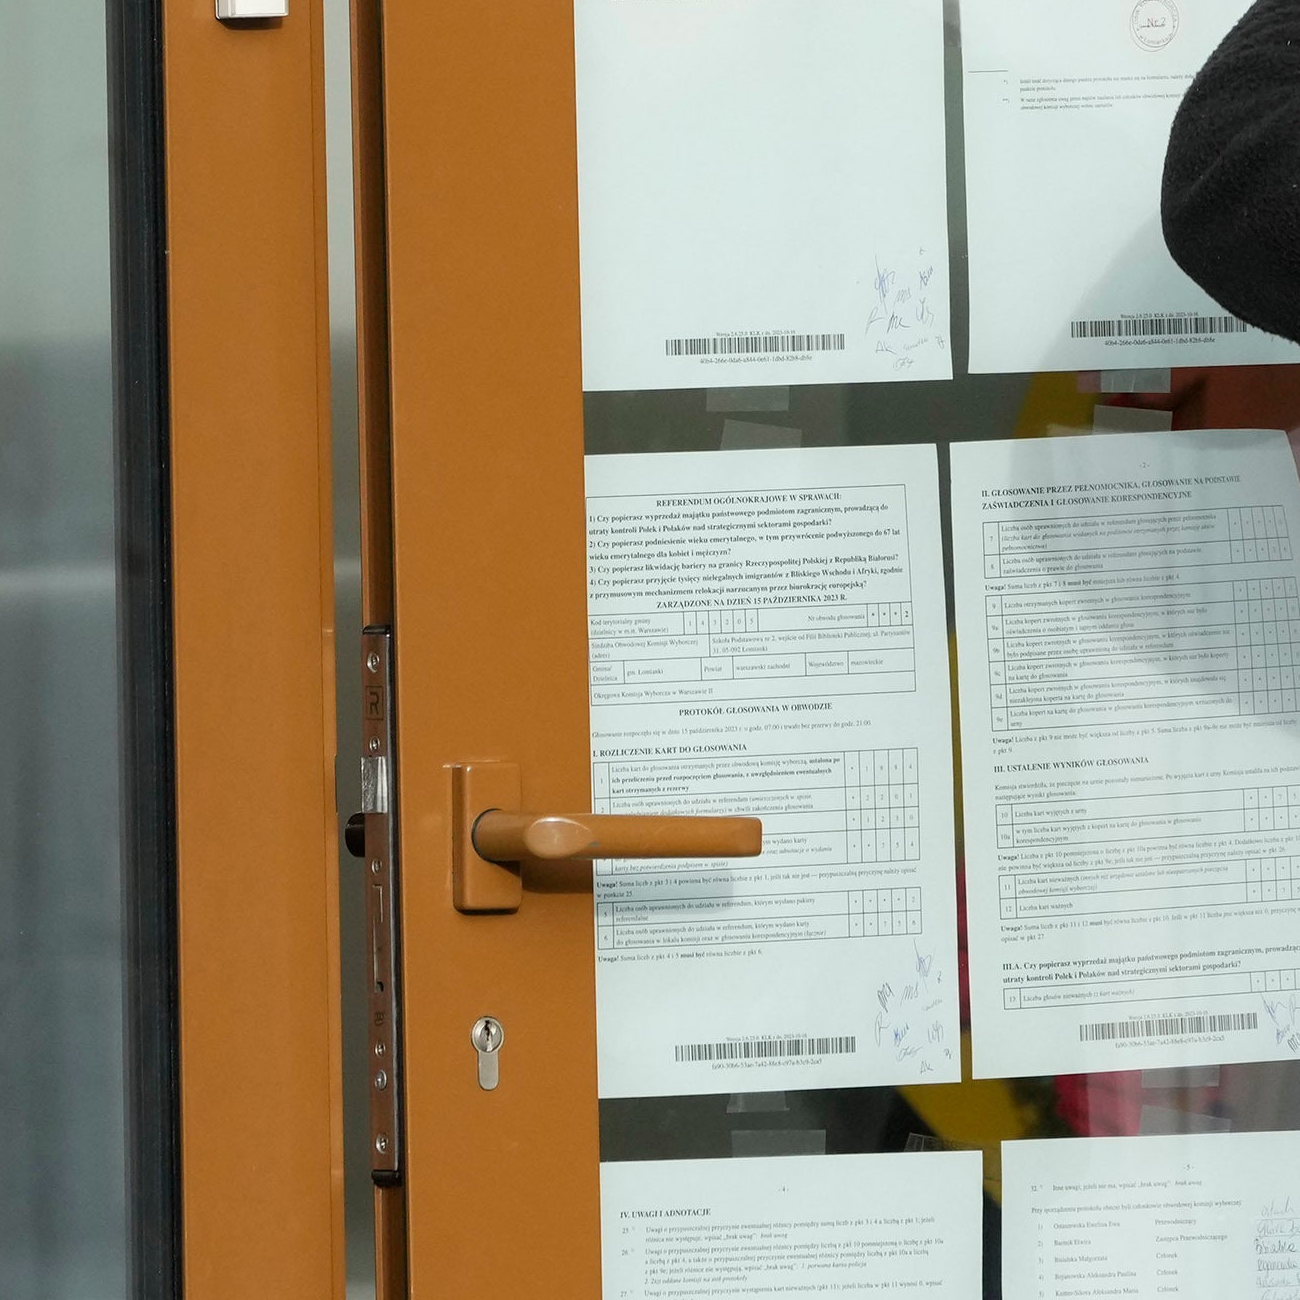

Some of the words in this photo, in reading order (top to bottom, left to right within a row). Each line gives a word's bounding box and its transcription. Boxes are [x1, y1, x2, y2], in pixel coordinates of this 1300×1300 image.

[981, 490, 990, 498] II.
[991, 486, 1045, 497] GŁOSOWANIE
[1046, 485, 1073, 494] PRZEZ
[1074, 482, 1141, 492] PEŁNOMOCNIKA,
[1141, 478, 1192, 488] GŁOSOWANIE
[656, 498, 712, 507] REFERENDUM
[713, 495, 788, 505] OGÓLNOKRAJOWE
[982, 499, 1049, 510] ZAŚWIADCZENIA
[1056, 496, 1110, 506] GŁOSOWANIE
[1111, 491, 1192, 502] KORESPONDENCYJNE
[656, 600, 712, 609] ZARZĄDZONE
[726, 596, 752, 606] DZIEŃ
[754, 597, 762, 605] 15
[763, 595, 822, 604] PAŹDZIERNIKA
[823, 594, 839, 602] 2023
[679, 706, 725, 716] PROTOKÓŁ
[726, 705, 780, 714] GŁOSOWANIA
[791, 702, 833, 711] OBWODZIE
[599, 748, 653, 757] ROZLICZENIE
[655, 746, 677, 755] KART
[679, 746, 692, 754] DO
[692, 744, 747, 753] GŁOSOWANIA
[994, 765, 1006, 773] III.
[1007, 762, 1051, 772] USTALENIE
[1052, 759, 1095, 769] WYNIKÓW
[1096, 757, 1149, 766] GŁOSOWANIA
[620, 1211, 630, 1219] IV.
[632, 1210, 658, 1218] UWAGI
[664, 1208, 711, 1217] ADNOTACJE
